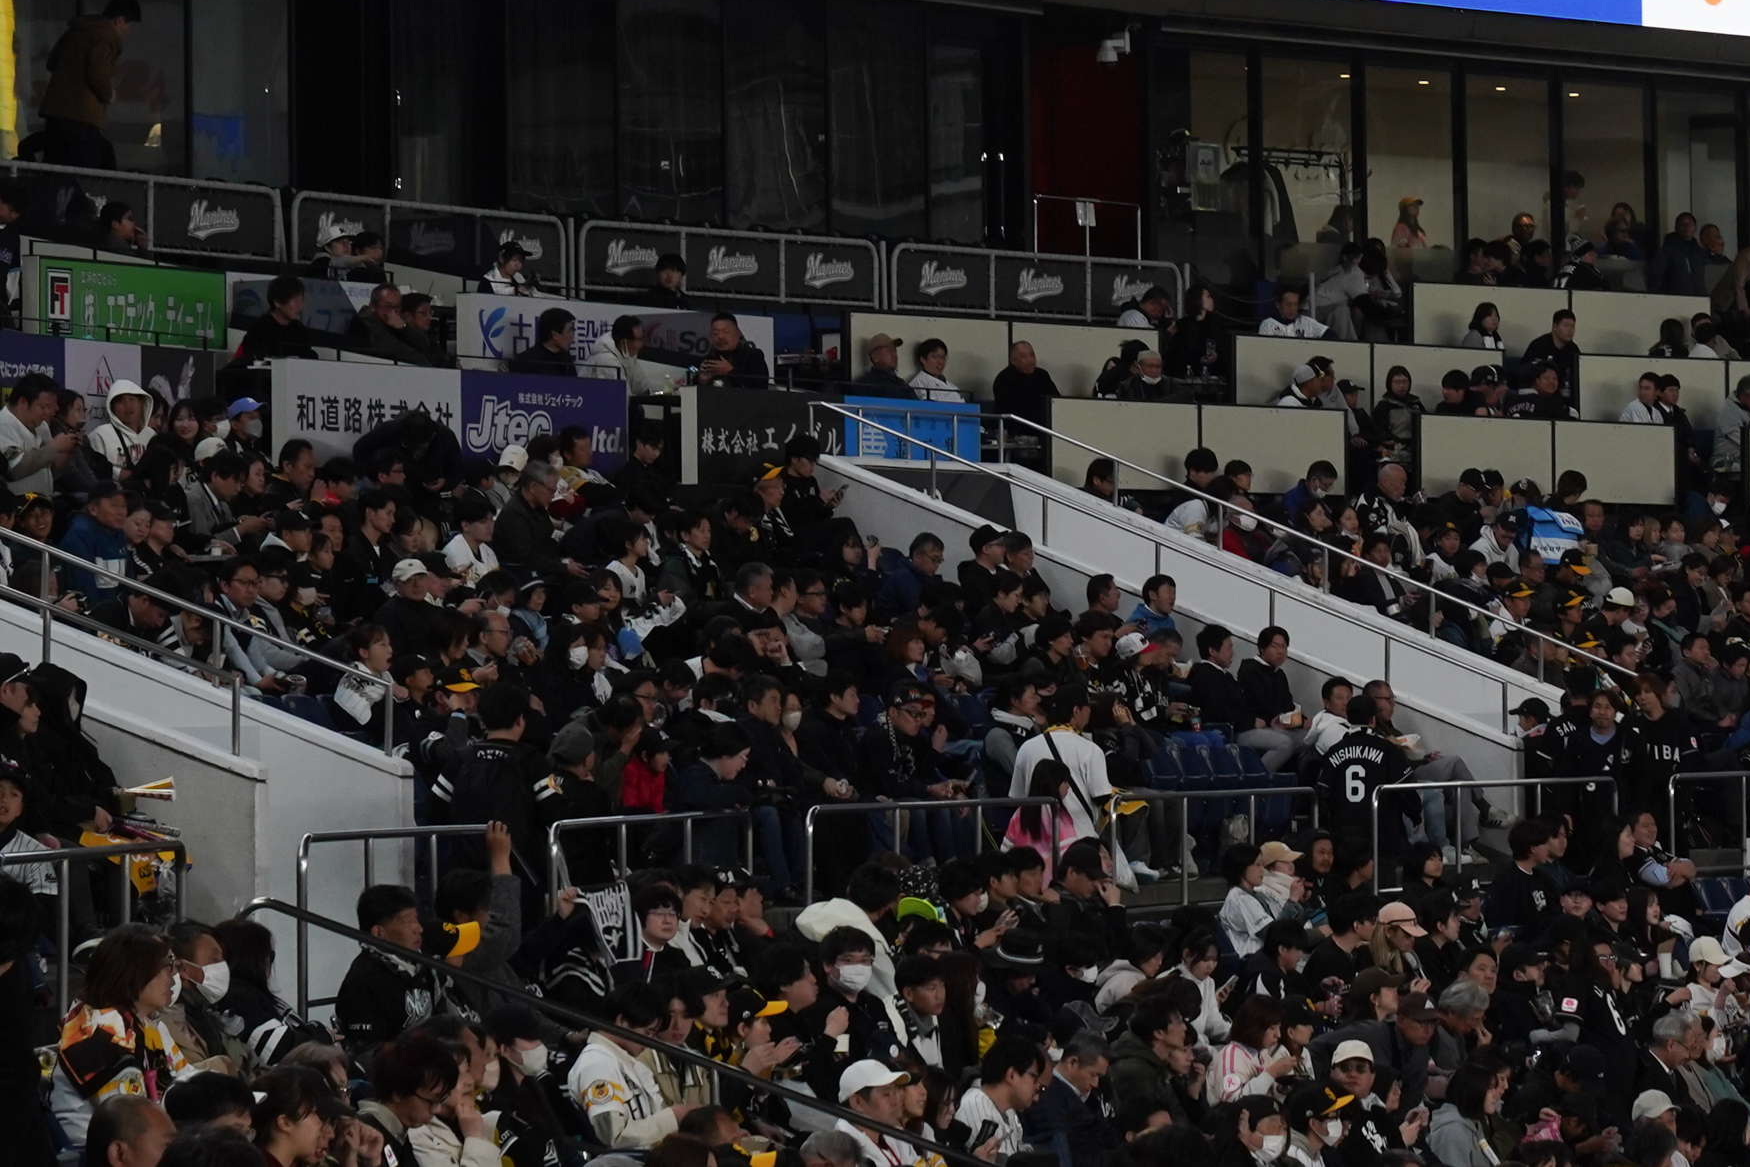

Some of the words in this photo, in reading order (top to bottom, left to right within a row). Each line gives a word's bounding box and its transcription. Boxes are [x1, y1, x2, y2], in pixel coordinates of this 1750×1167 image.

[187, 199, 240, 239] Marines
[605, 239, 660, 276] Marines
[706, 245, 759, 282] Marines
[804, 252, 856, 289] Marines
[918, 260, 968, 296] Marines
[1016, 267, 1065, 303] Marines
[465, 394, 553, 454] Jtec
[1328, 745, 1385, 769] NISHIKAWA
[1344, 764, 1367, 803] 6
